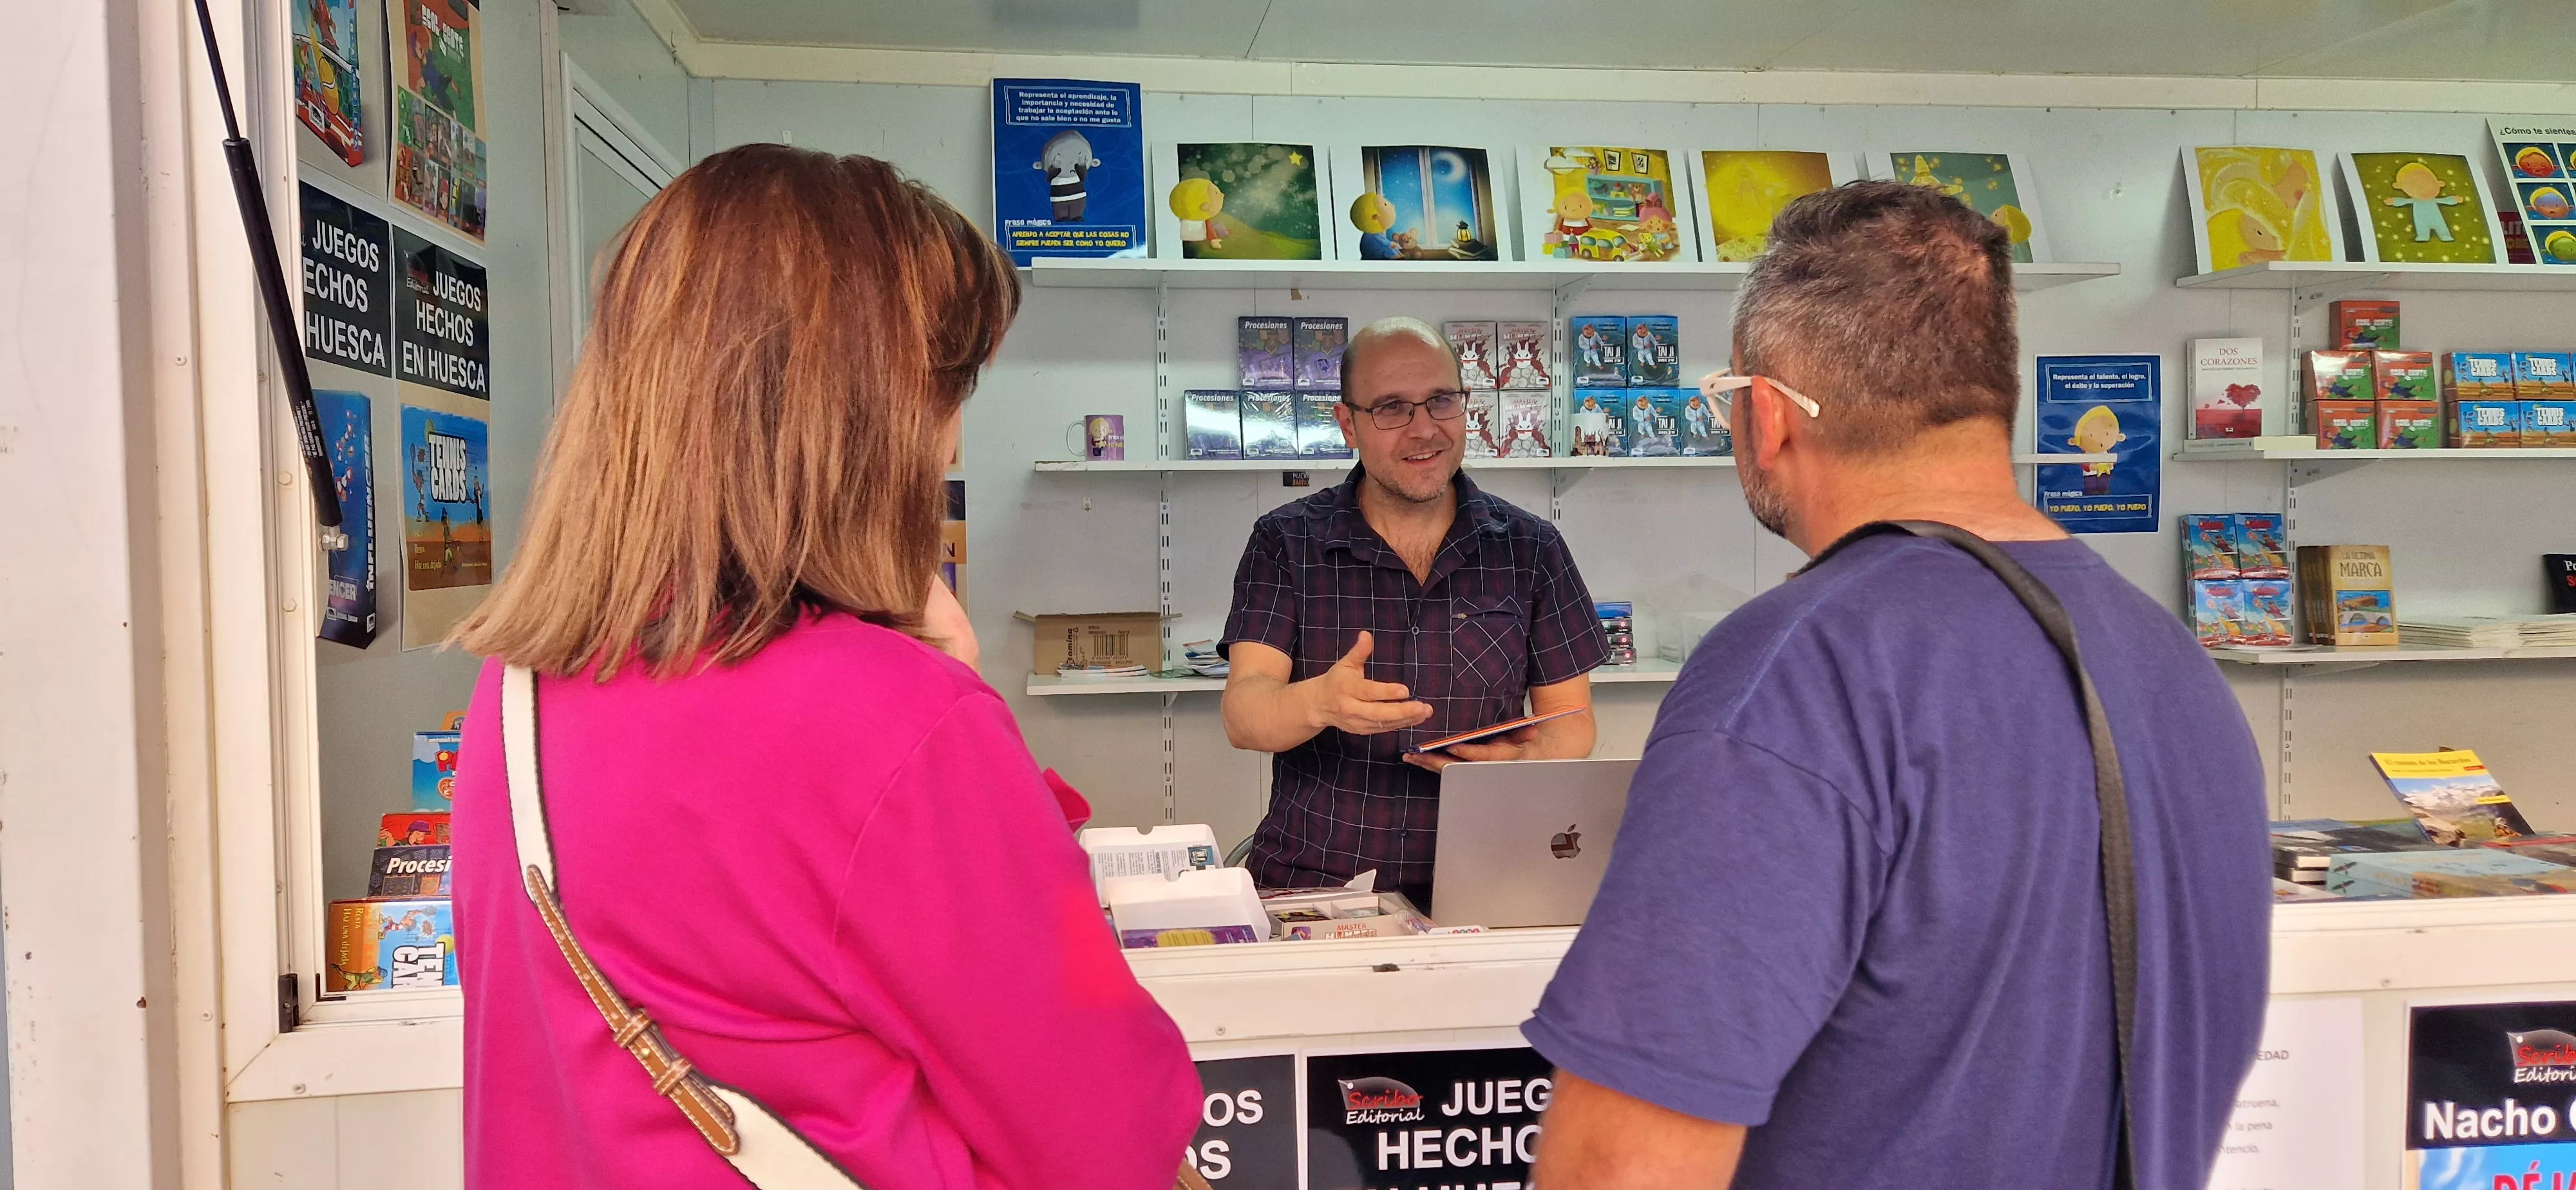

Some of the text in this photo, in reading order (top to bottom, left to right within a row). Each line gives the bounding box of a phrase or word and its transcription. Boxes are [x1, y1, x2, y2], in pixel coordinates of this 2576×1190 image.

[1018, 106, 1045, 115] trabajar
[1101, 116, 1121, 124] gusta
[2499, 127, 2532, 136] ¿Cómo
[312, 220, 379, 273] JUEGOS
[433, 270, 482, 312] JUEGOS
[415, 299, 474, 347] HECHOS
[1244, 321, 1287, 330] Procesiones
[1300, 321, 1343, 330] Procesiones
[306, 310, 386, 369] HUESCA
[402, 339, 486, 393] EN HUESCA
[2201, 357, 2257, 366] CORAZONES
[1191, 393, 1234, 402] Procesiones
[428, 434, 466, 469] TENNIS
[430, 466, 466, 502] CARDS
[2340, 562, 2382, 577] MARCA
[387, 856, 453, 875] Procesi
[1337, 923, 1367, 931] MASTER
[1349, 1088, 1422, 1109] Scribo
[1441, 1078, 1553, 1117] JUEG
[1345, 1108, 1425, 1125] Editorial
[2424, 1097, 2556, 1140] Nacho
[2247, 1122, 2273, 1133] pena
